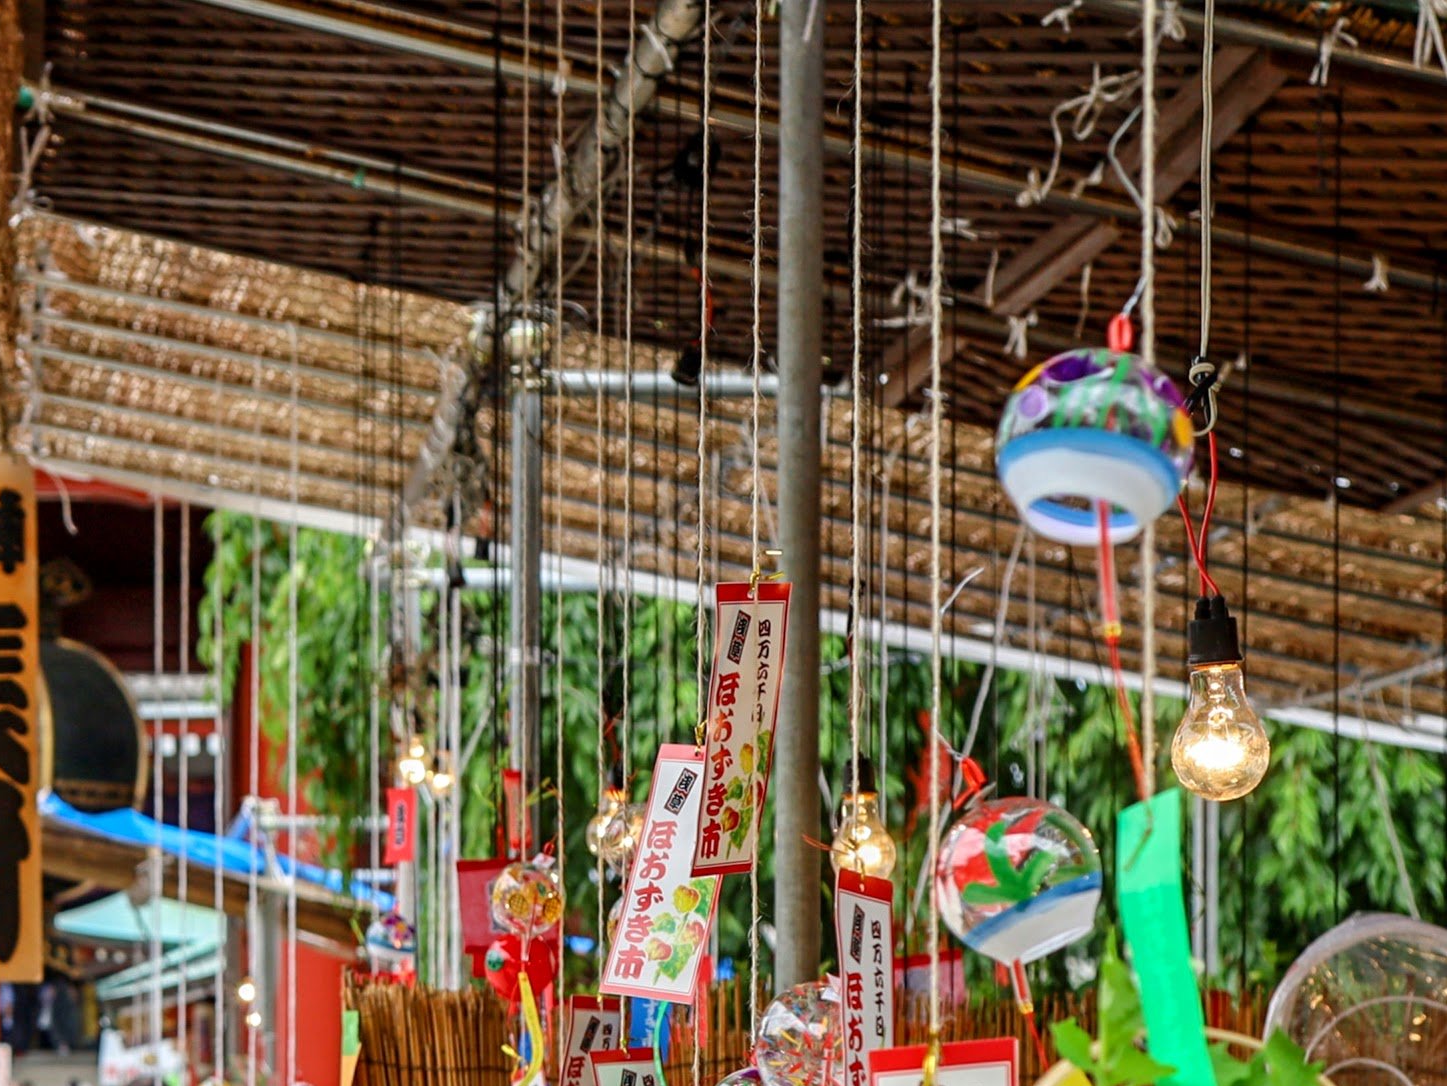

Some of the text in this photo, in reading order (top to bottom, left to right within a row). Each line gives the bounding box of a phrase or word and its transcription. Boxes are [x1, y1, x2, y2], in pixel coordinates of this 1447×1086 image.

[701, 672, 741, 859] ほおずき市
[614, 820, 679, 980] ほおずき市
